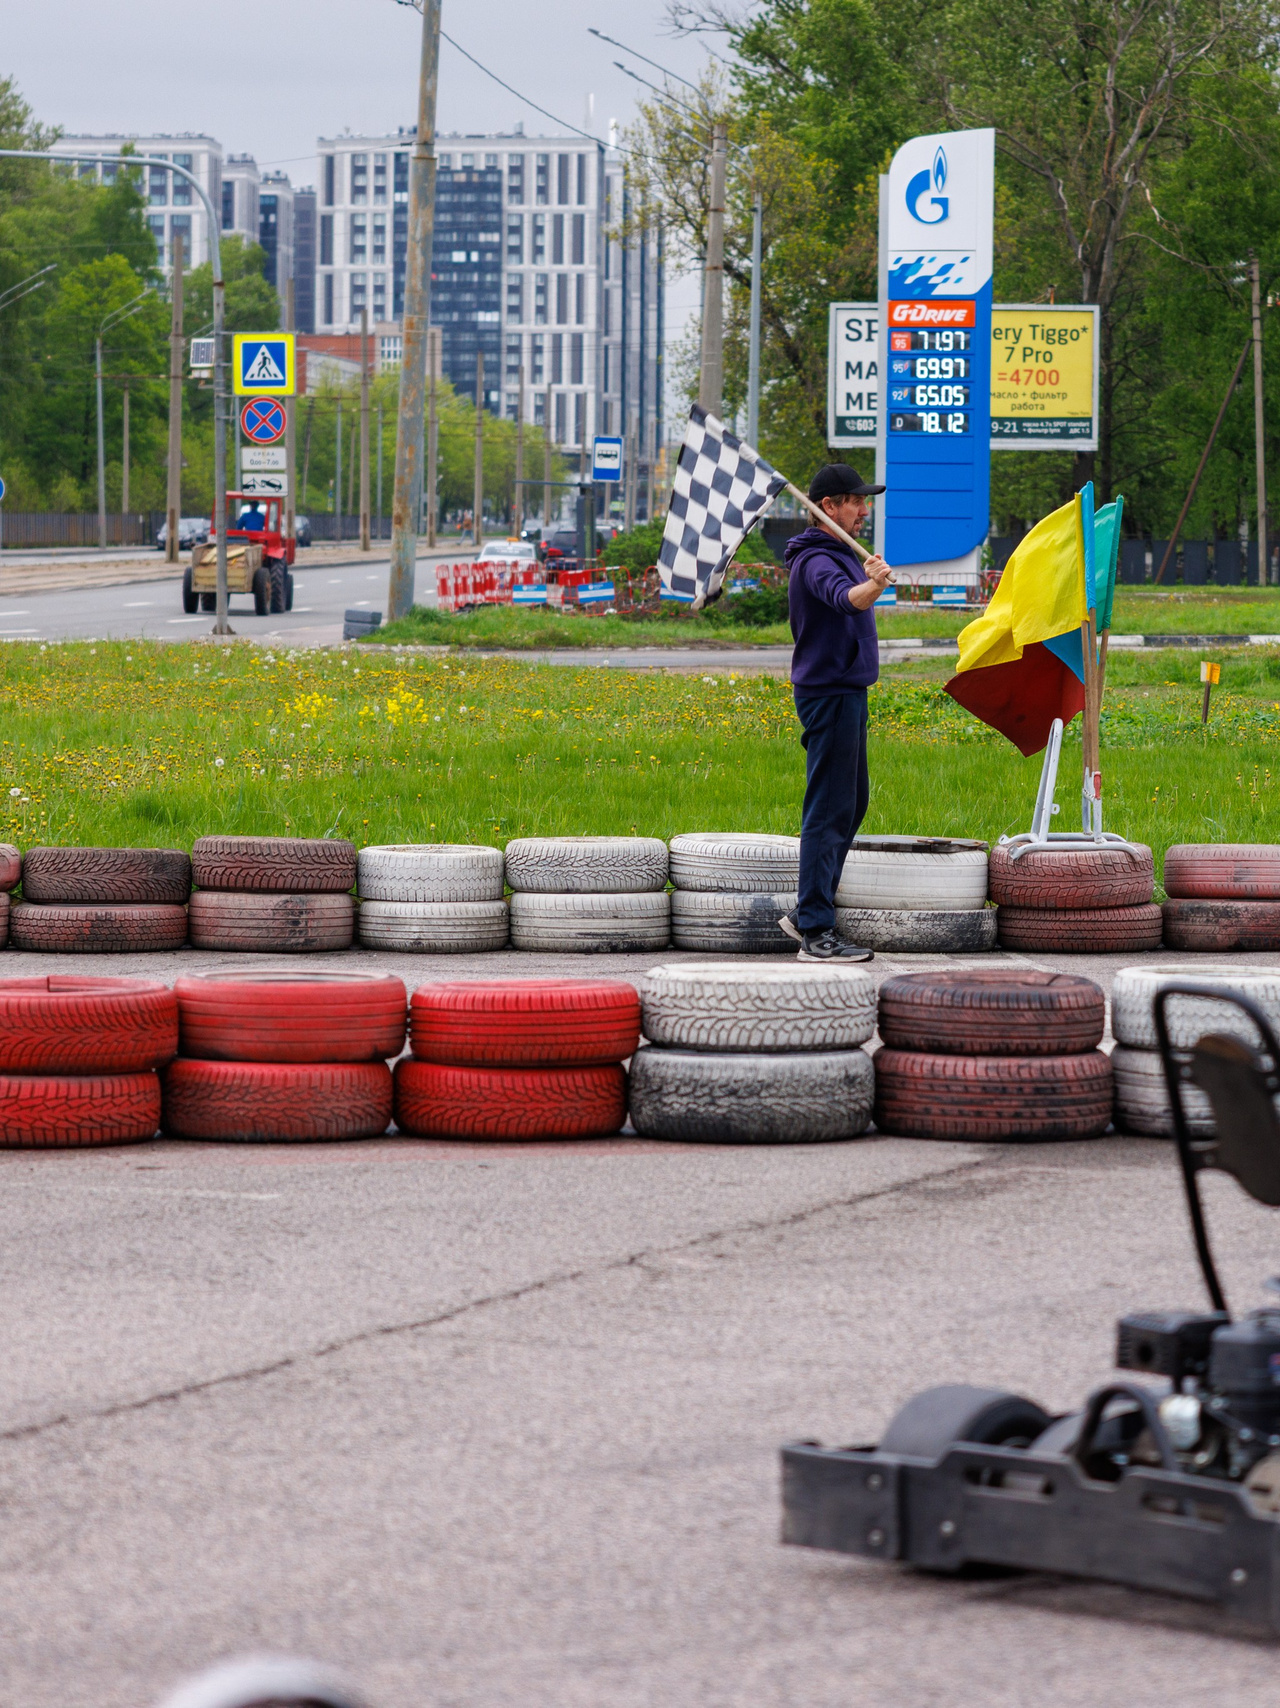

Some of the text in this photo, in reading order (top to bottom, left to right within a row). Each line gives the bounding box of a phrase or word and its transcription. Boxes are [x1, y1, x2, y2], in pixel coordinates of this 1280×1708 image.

[894, 331, 965, 351] 95 71.97
[1004, 346, 1053, 363] 7 Pro
[892, 357, 965, 379] 95 69.97
[997, 369, 1060, 386] =4700
[892, 385, 965, 406] 92 65.05
[1030, 391, 1068, 400] фильтр
[1010, 403, 1046, 412] работа
[895, 412, 965, 433] D 78.12
